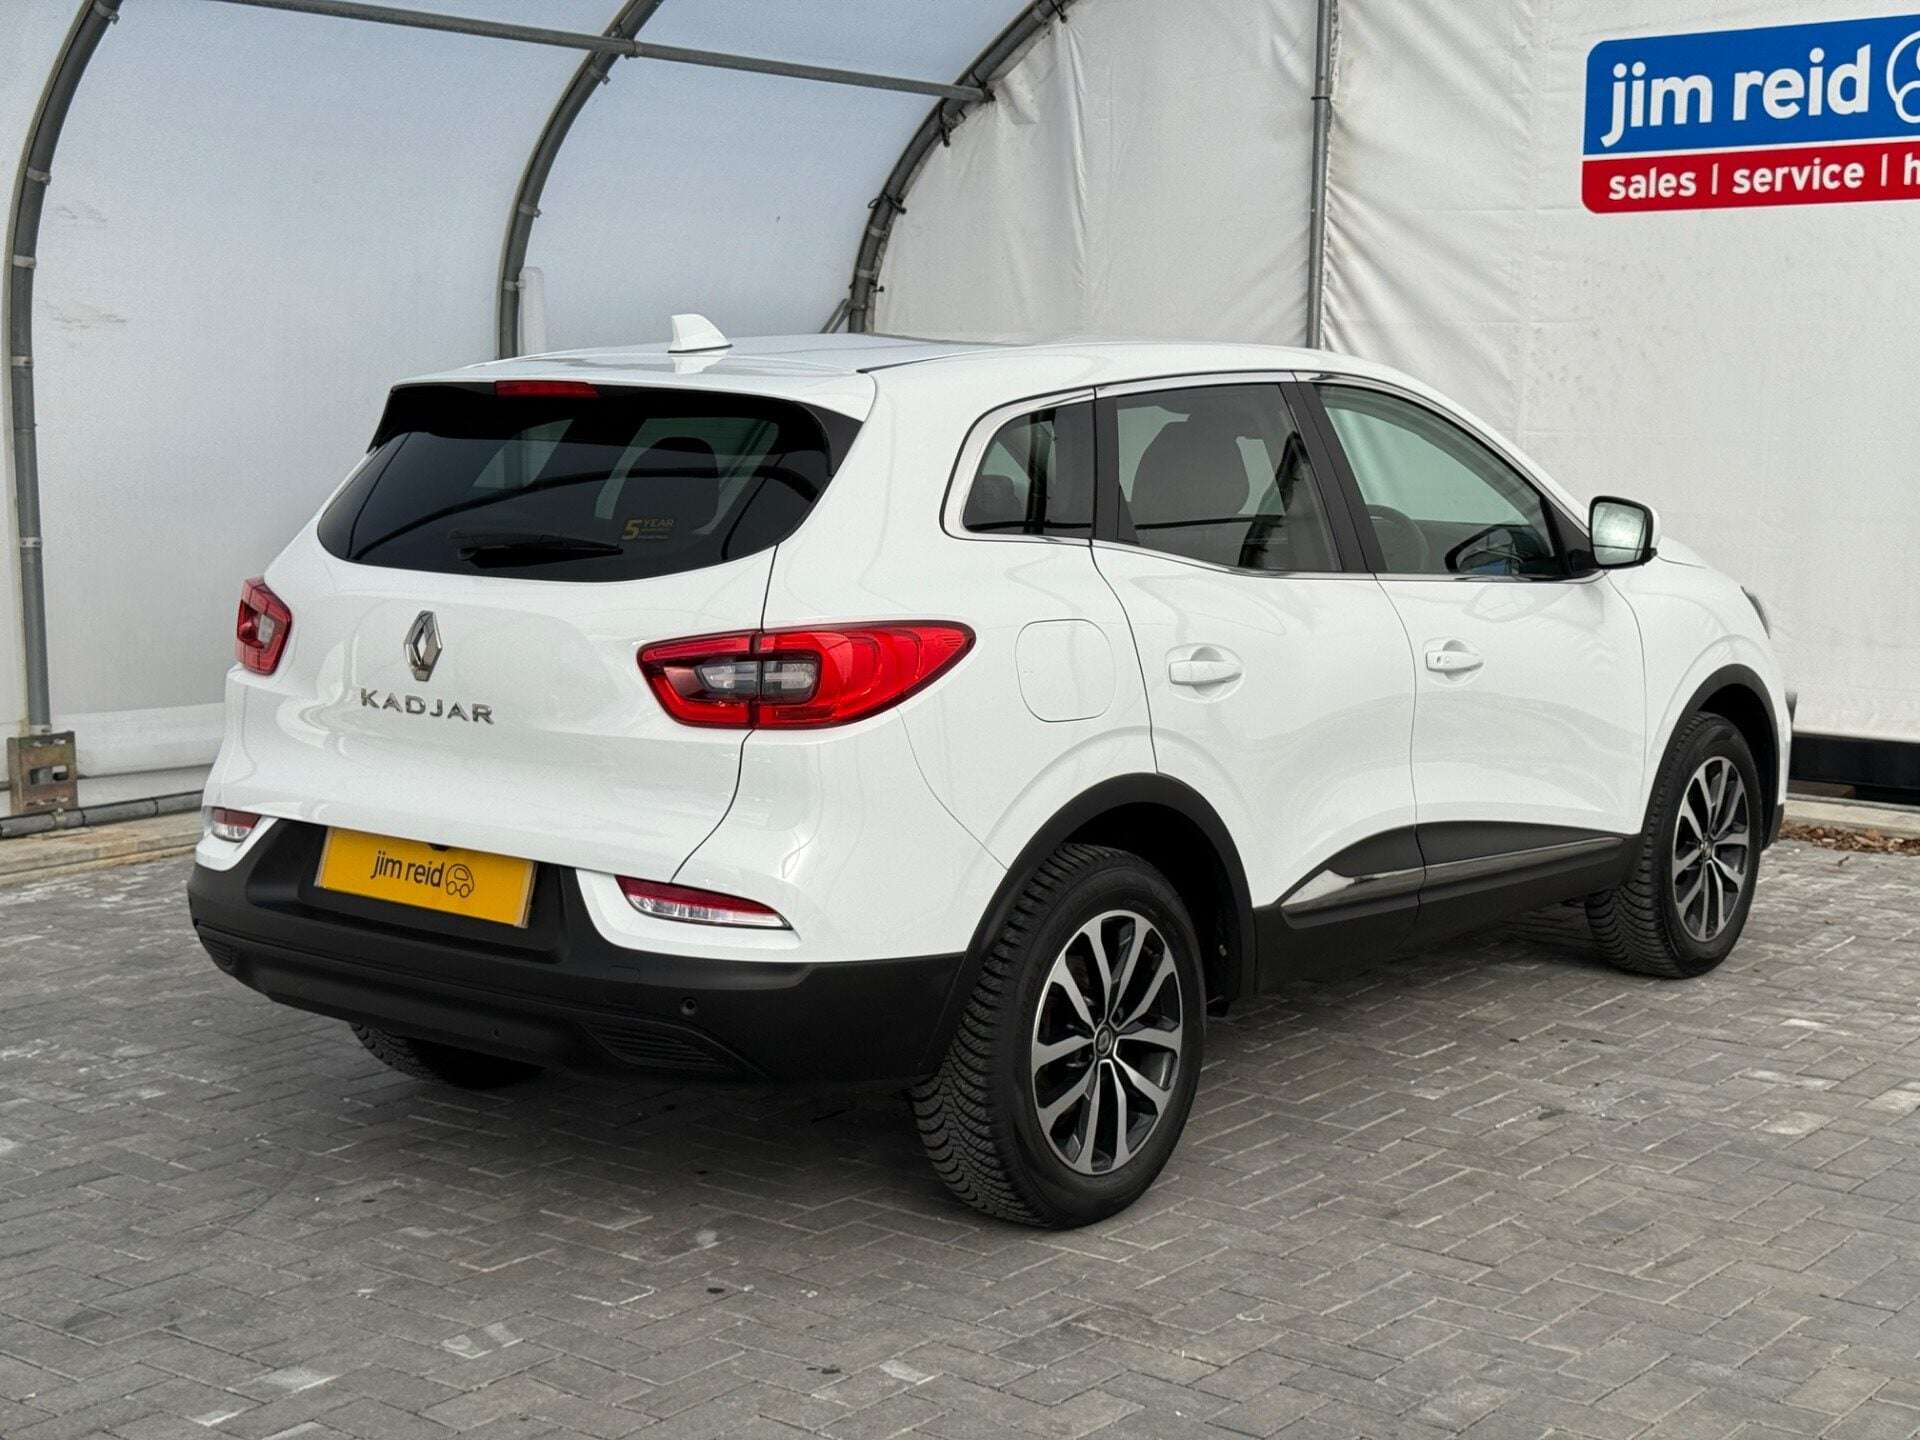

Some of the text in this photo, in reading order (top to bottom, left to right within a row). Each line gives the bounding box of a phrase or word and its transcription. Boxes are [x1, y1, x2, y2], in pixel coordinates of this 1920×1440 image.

[1600, 43, 1871, 148] jim reid
[1608, 166, 1697, 200] sales
[1732, 157, 1865, 194] service
[360, 687, 495, 725] KADJAR
[370, 850, 446, 888] jim reid
